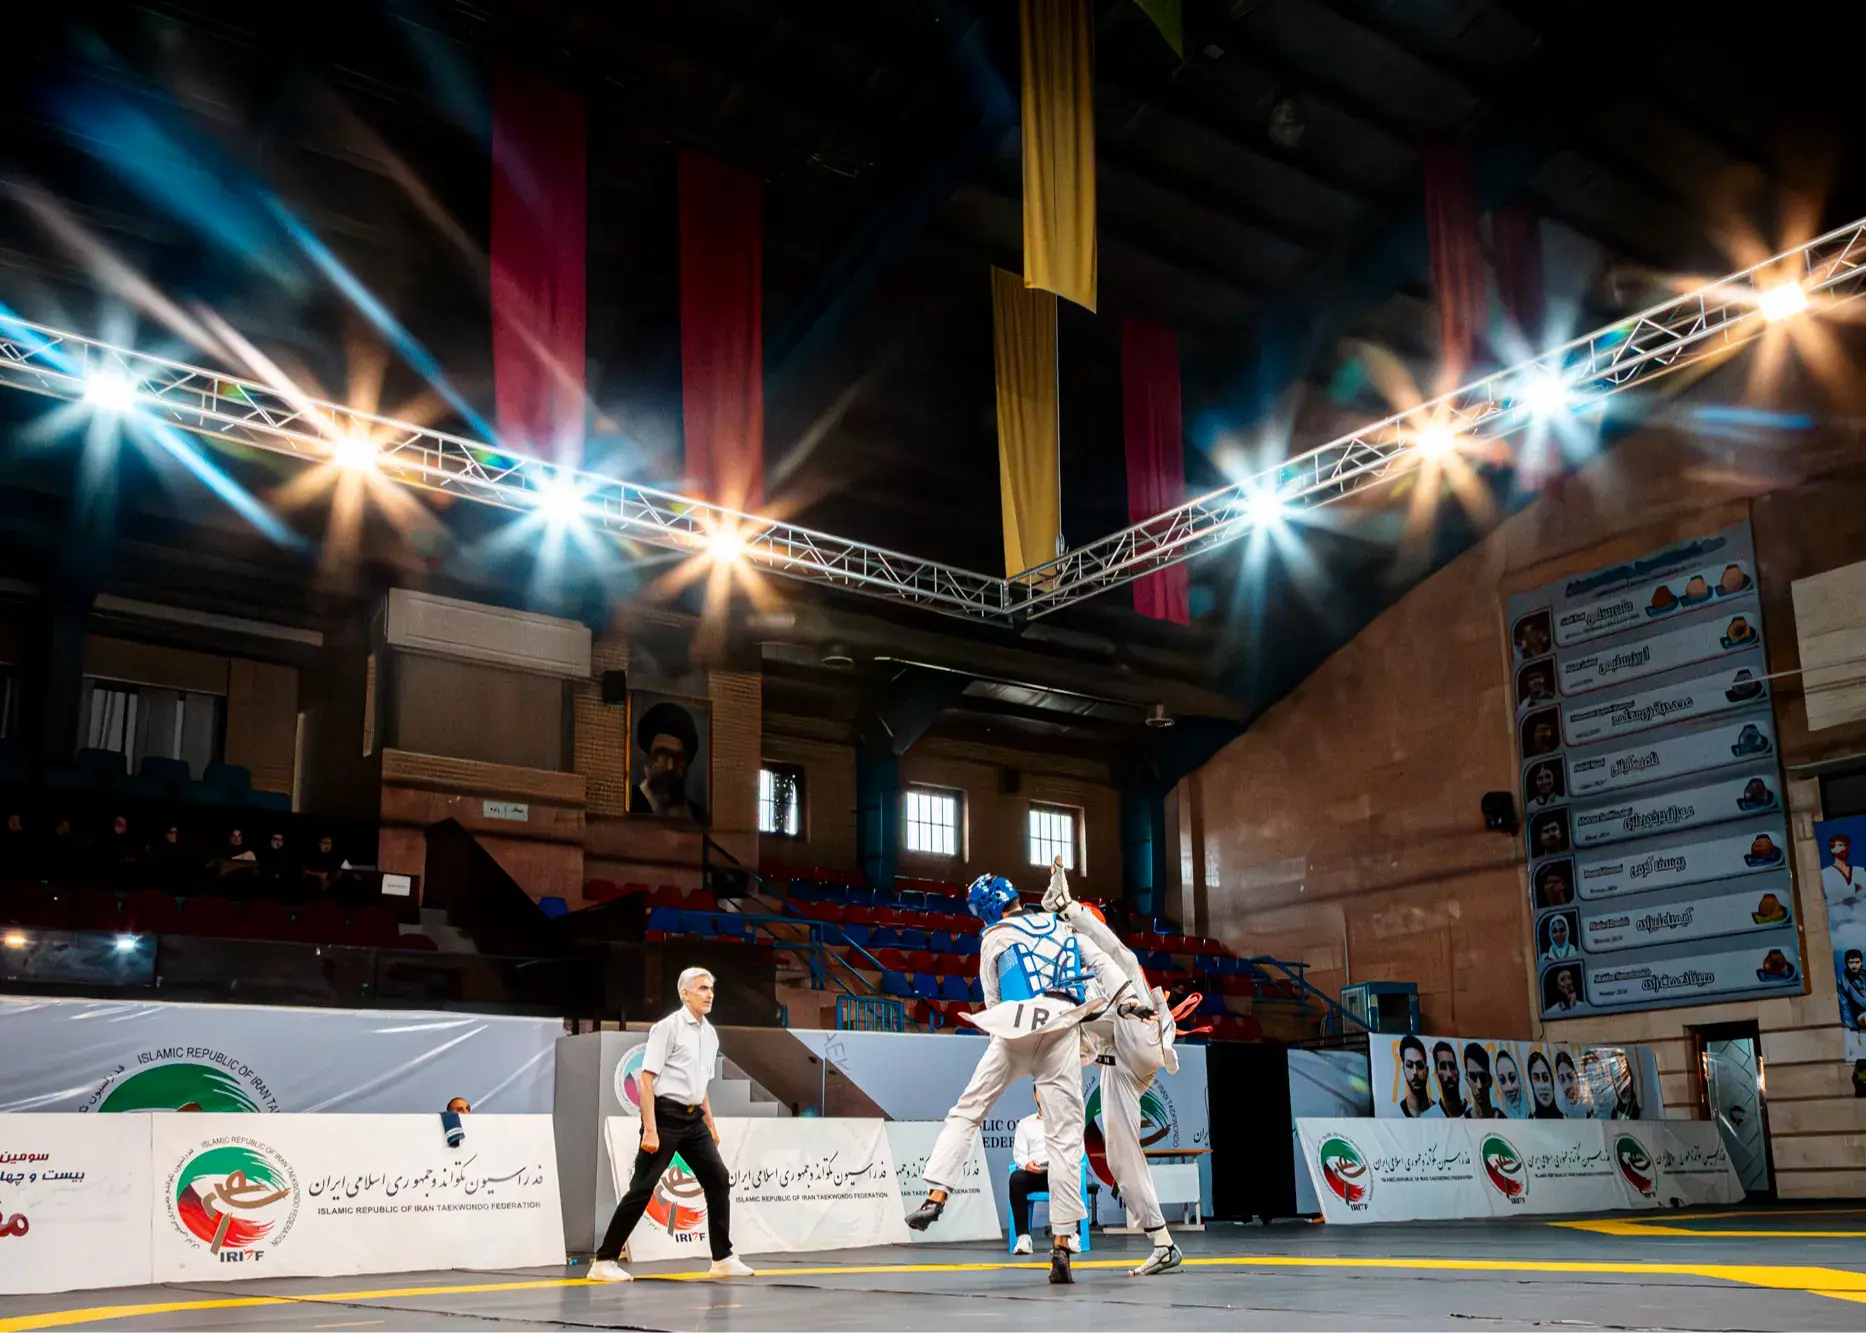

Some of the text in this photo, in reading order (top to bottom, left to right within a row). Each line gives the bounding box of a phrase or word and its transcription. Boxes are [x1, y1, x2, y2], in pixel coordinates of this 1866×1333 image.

[137, 1047, 272, 1101] ISLAMIC REPUBLIC OF IRAN
[200, 1136, 230, 1148] ISLAMIC
[231, 1136, 266, 1152] REPUBLIC
[0, 1151, 49, 1164] سومین
[29, 1172, 37, 1183] و
[42, 1170, 85, 1183] بیست
[736, 1195, 761, 1203] ISLAMIC
[318, 1201, 541, 1216] ISLAMIC REPUBLIC OF IRAN TAEKWONDO FEDERATION
